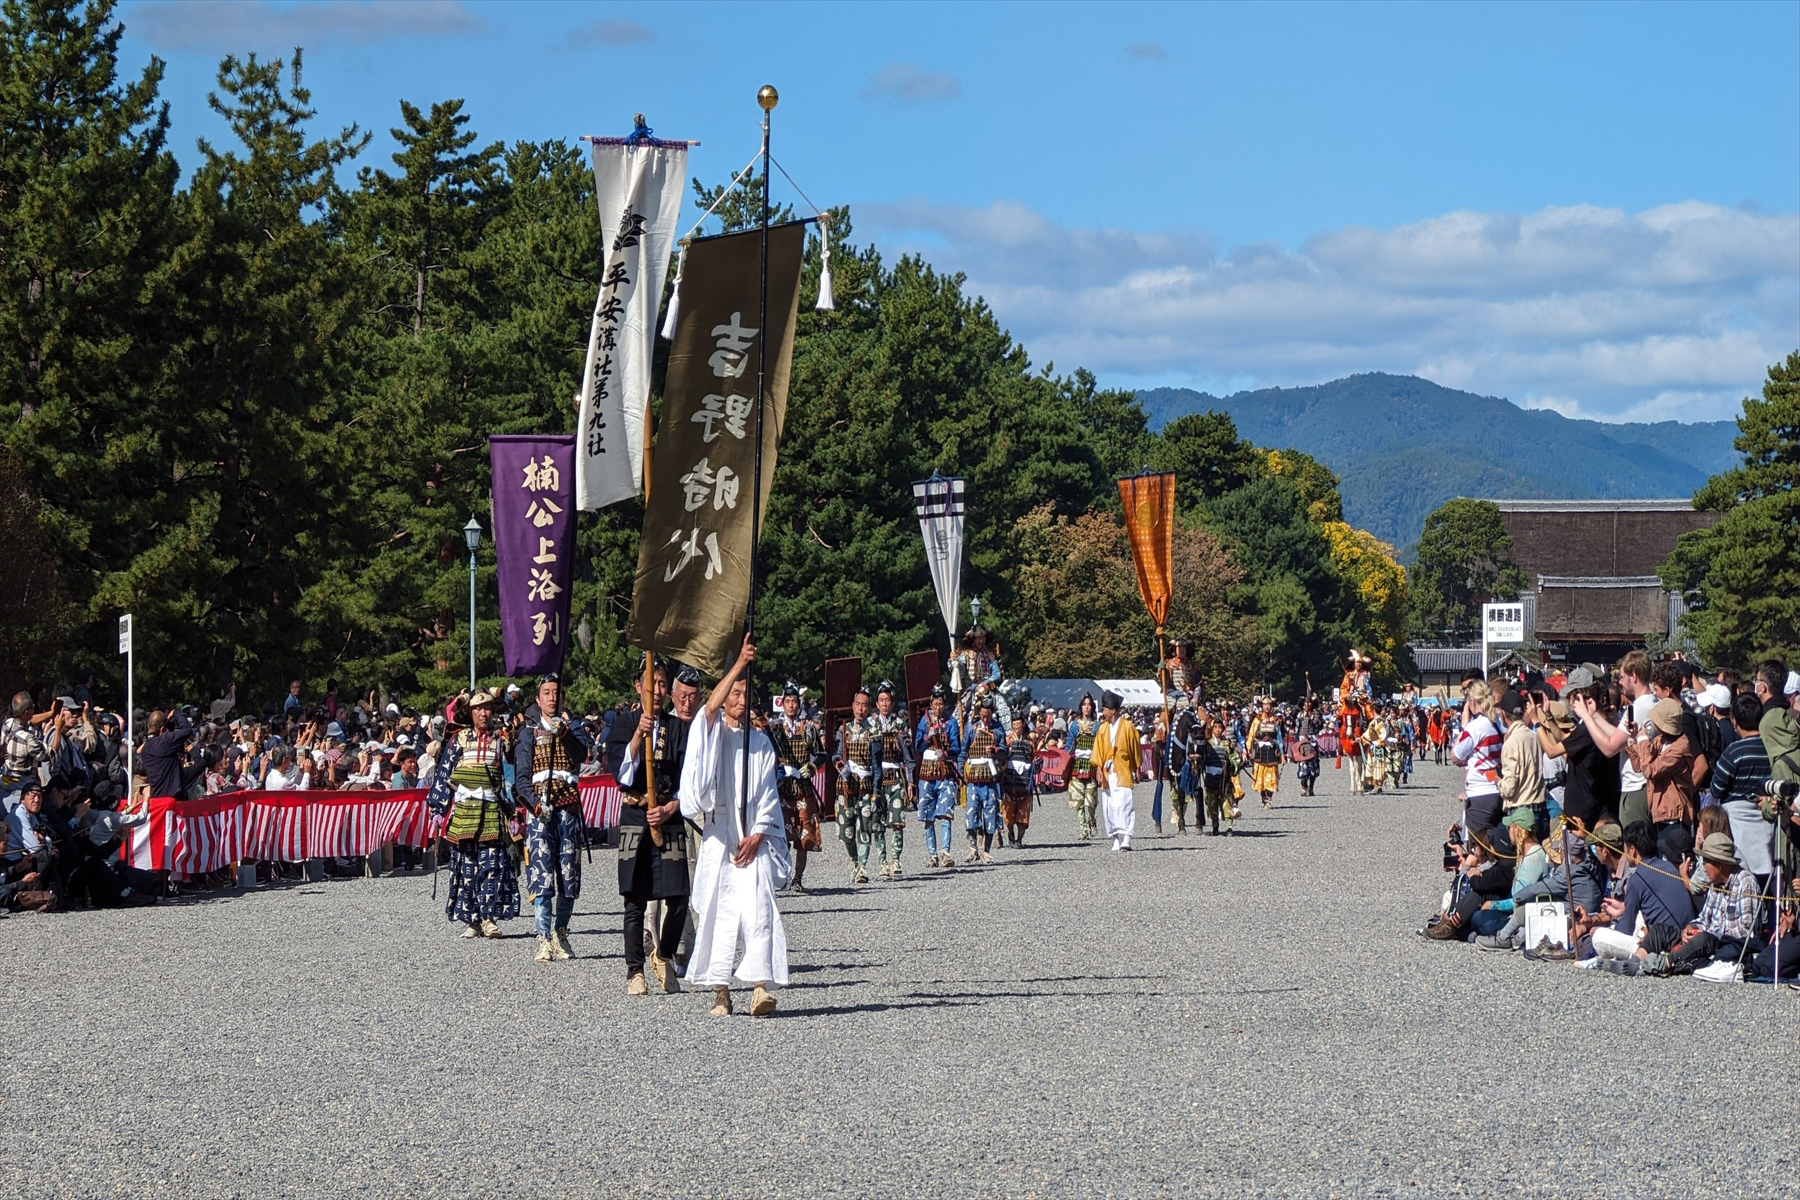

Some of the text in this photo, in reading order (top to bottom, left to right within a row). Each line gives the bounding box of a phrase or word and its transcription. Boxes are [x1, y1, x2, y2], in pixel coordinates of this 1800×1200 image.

[587, 261, 631, 458] 平安講社第九社
[520, 455, 564, 646] 楠公上洛列
[1489, 608, 1521, 622] 横断通路
